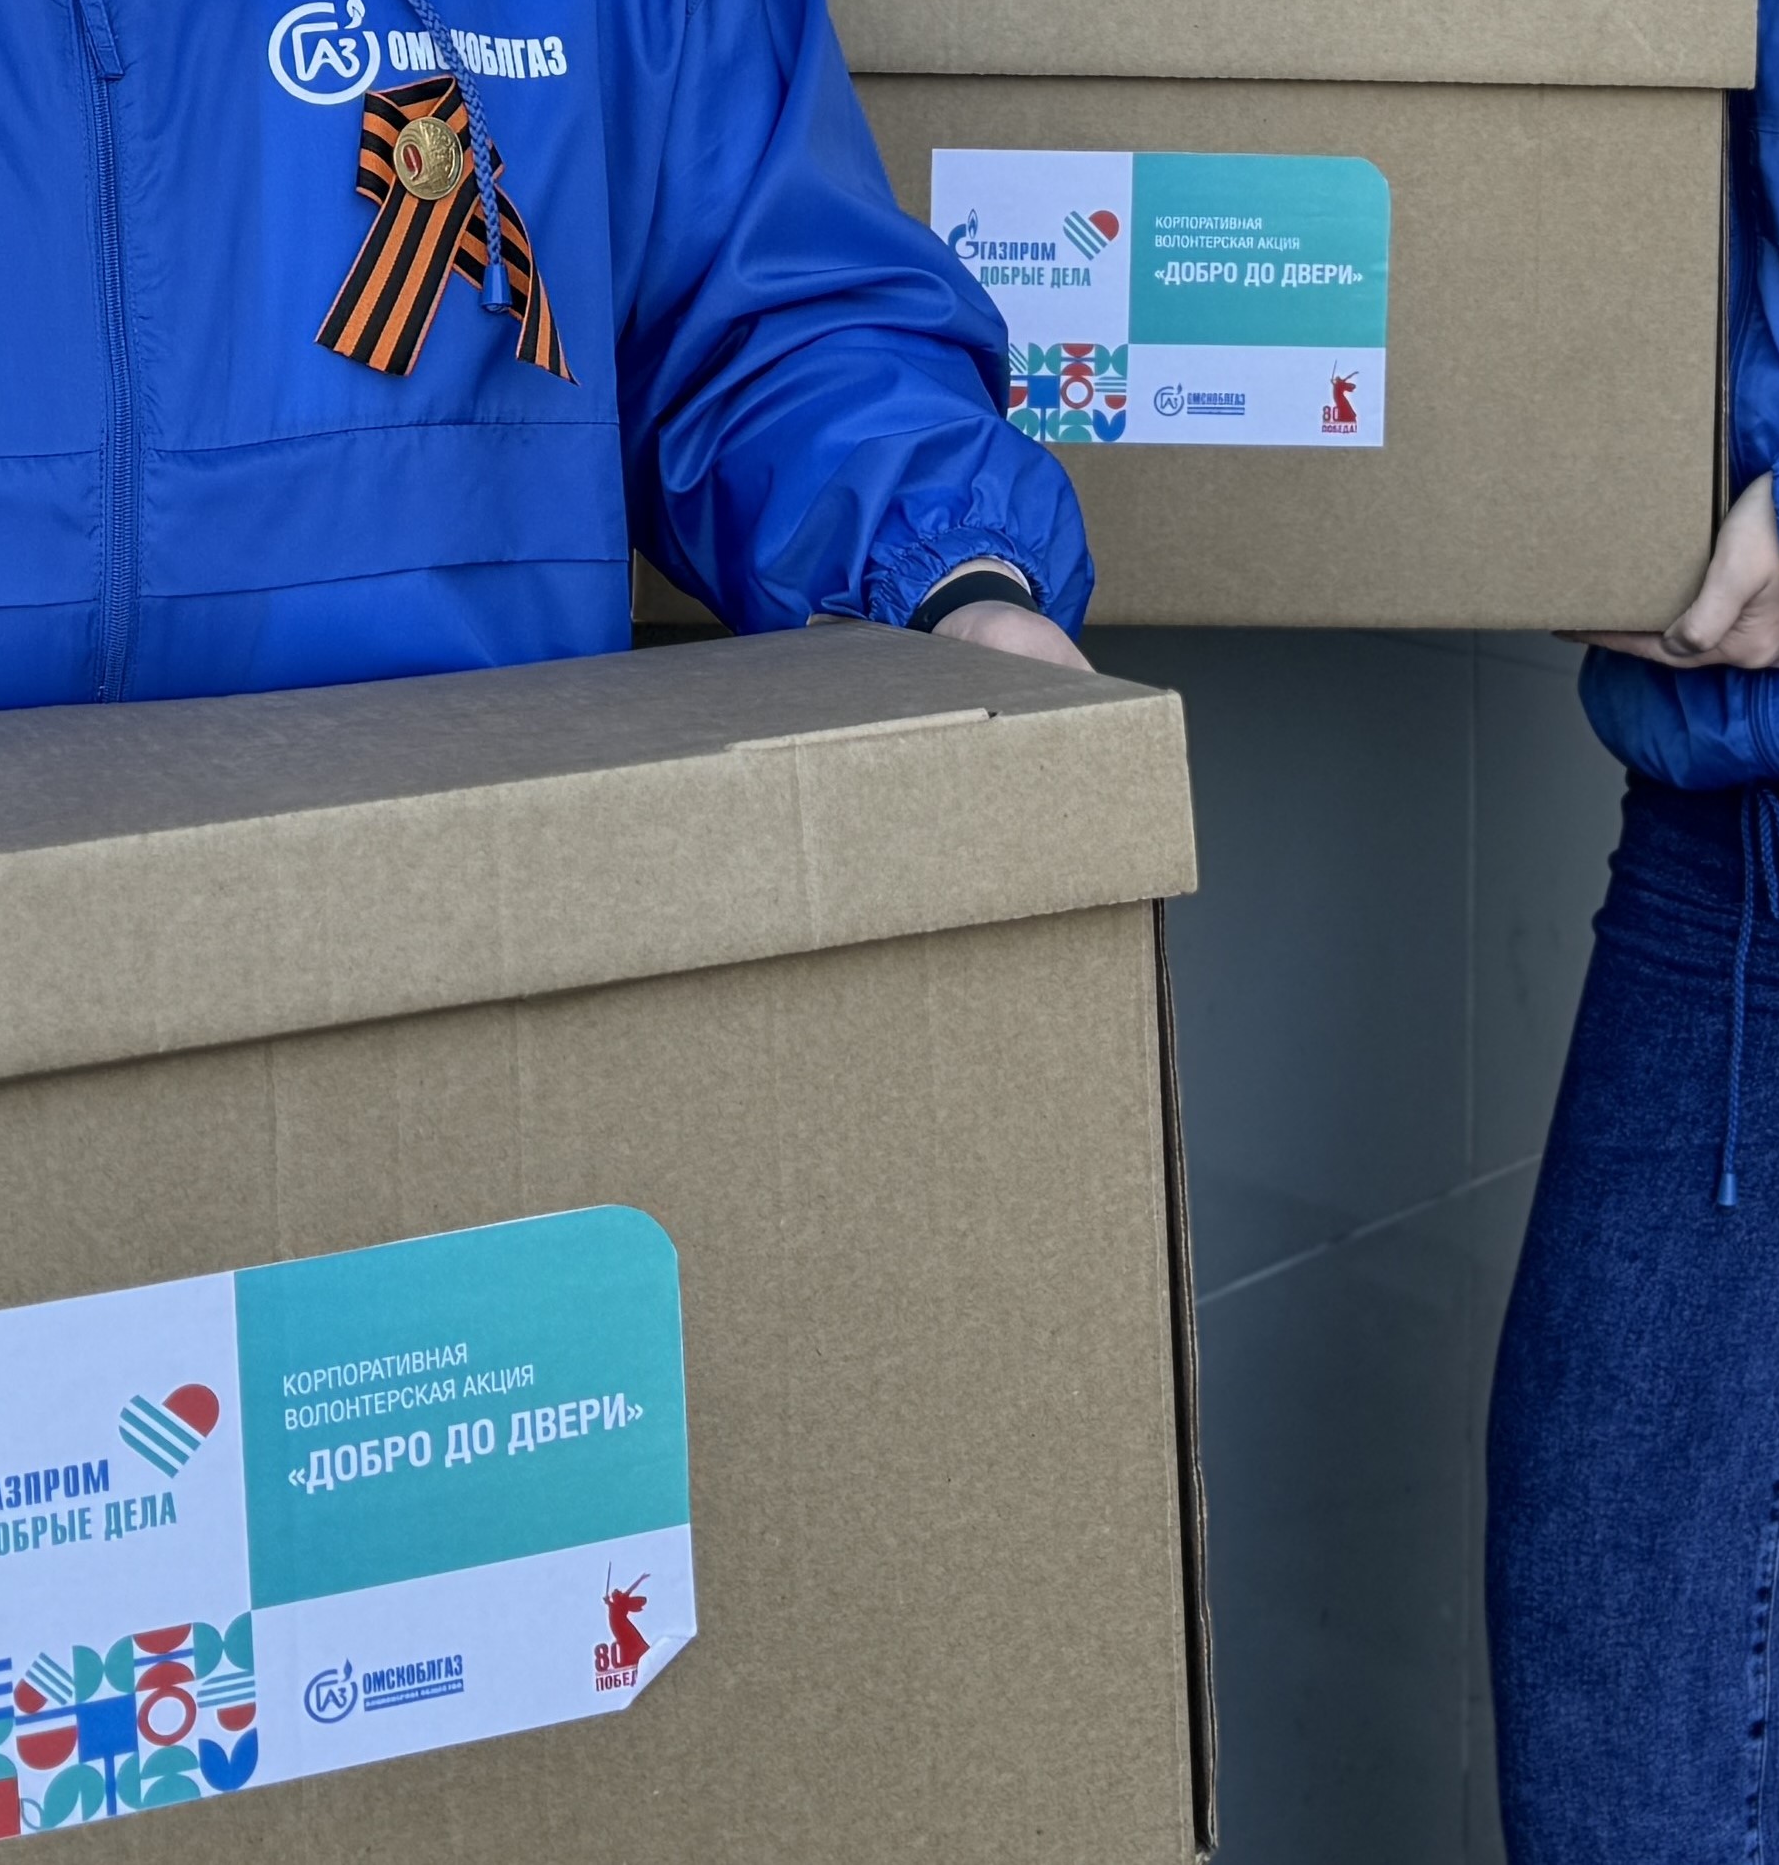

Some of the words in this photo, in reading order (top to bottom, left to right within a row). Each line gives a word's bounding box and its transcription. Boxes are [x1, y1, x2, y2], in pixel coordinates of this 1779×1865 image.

[1155, 215, 1263, 230] КОРПОРАТИВНАЯ
[980, 241, 1057, 262] ГАЗПРОМ
[1154, 235, 1254, 249] ВОЛОНТЕРСКАЯ
[1257, 237, 1301, 251] АКЦИЯ
[979, 265, 1045, 288] ДОБРЫЕ
[1050, 267, 1092, 289] ДЕЛА
[1154, 261, 1239, 286] «ДОБРО
[1243, 262, 1276, 287] ДО
[1281, 263, 1364, 287] ДВЕРИ»
[282, 1342, 468, 1397] КОРПОРАТИВНАЯ
[284, 1379, 456, 1431] ВОЛОНТЕРСКАЯ
[462, 1364, 534, 1398] АКЦИЯ
[288, 1430, 433, 1495] «ДОБРО
[443, 1418, 496, 1468] ДО
[507, 1392, 644, 1456] ДВЕРИ»
[104, 1491, 177, 1541] ДЕЛА
[362, 1654, 463, 1695] ОМСКОБЛГАЗ
